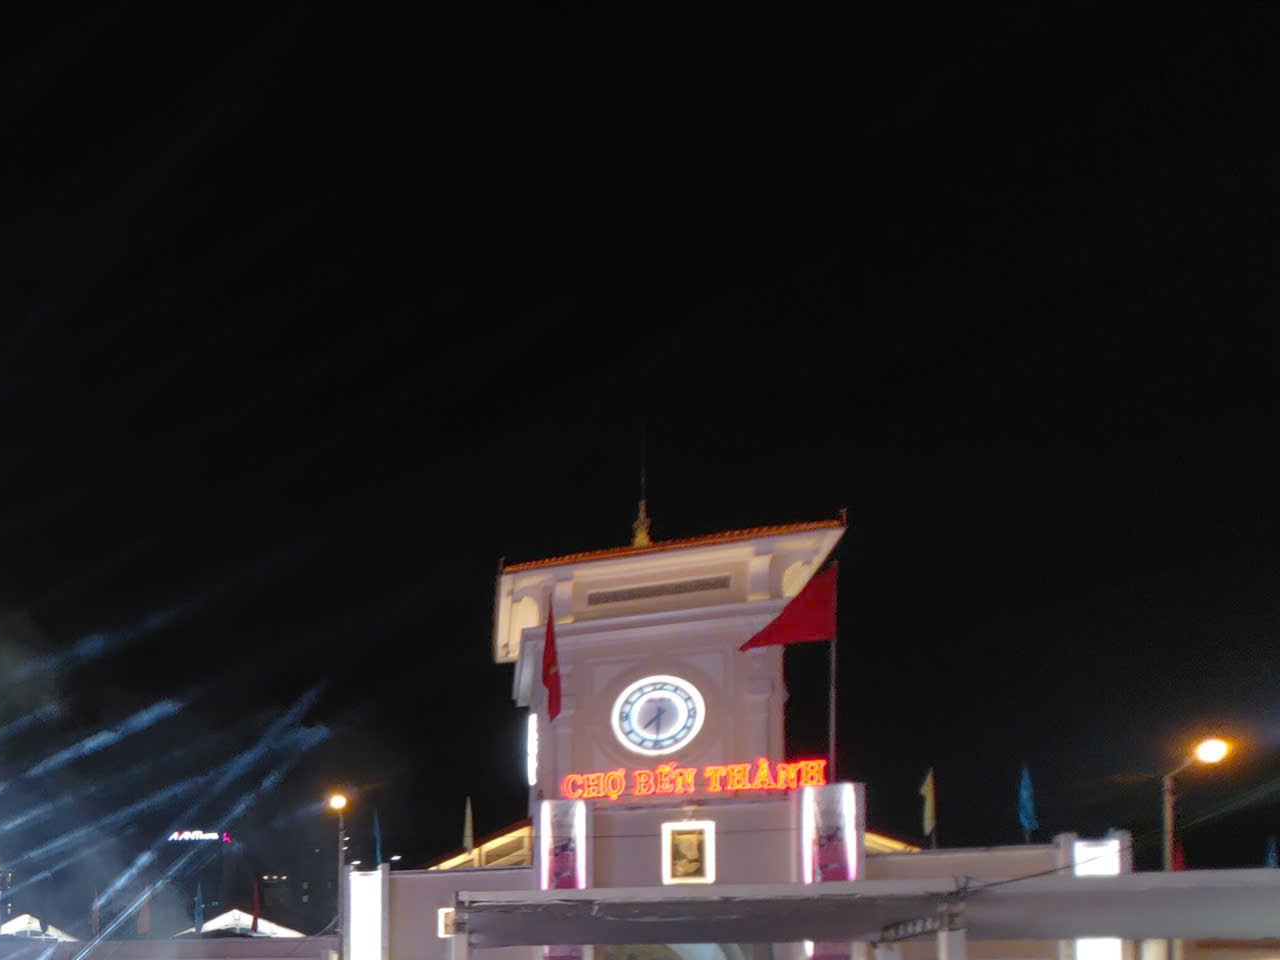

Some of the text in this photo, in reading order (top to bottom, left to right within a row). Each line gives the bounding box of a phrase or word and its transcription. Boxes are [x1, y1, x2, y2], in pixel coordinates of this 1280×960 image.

[563, 757, 827, 799] CHỢ BẾN THÀNH
